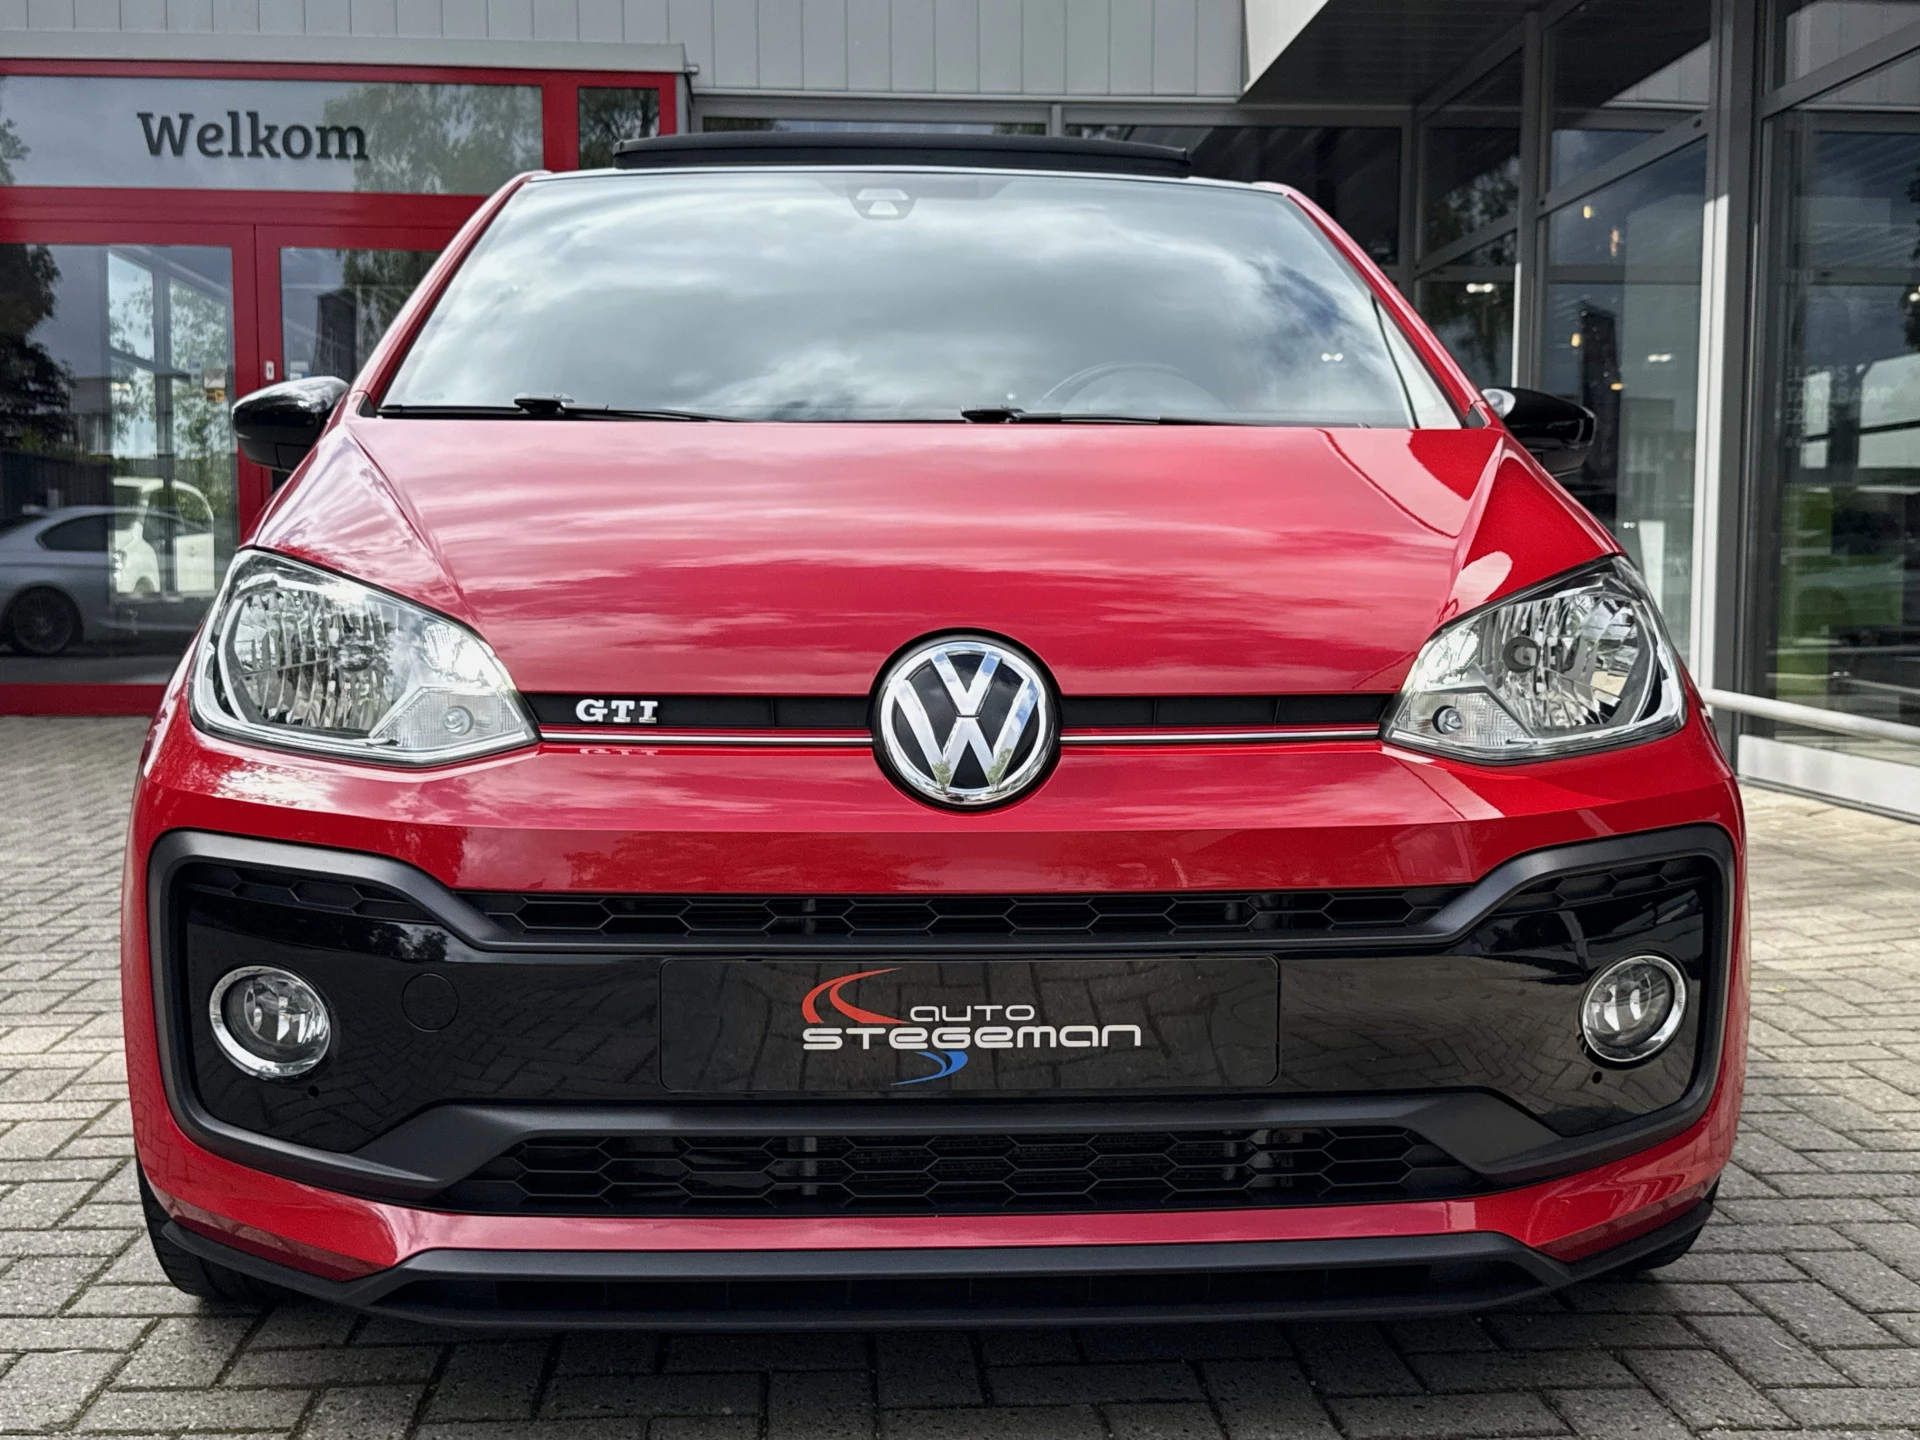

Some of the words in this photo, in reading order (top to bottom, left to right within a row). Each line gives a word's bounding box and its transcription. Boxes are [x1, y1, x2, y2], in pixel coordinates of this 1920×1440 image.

[136, 110, 370, 160] Welkom
[575, 698, 659, 724] GTI
[888, 647, 1042, 792] VW
